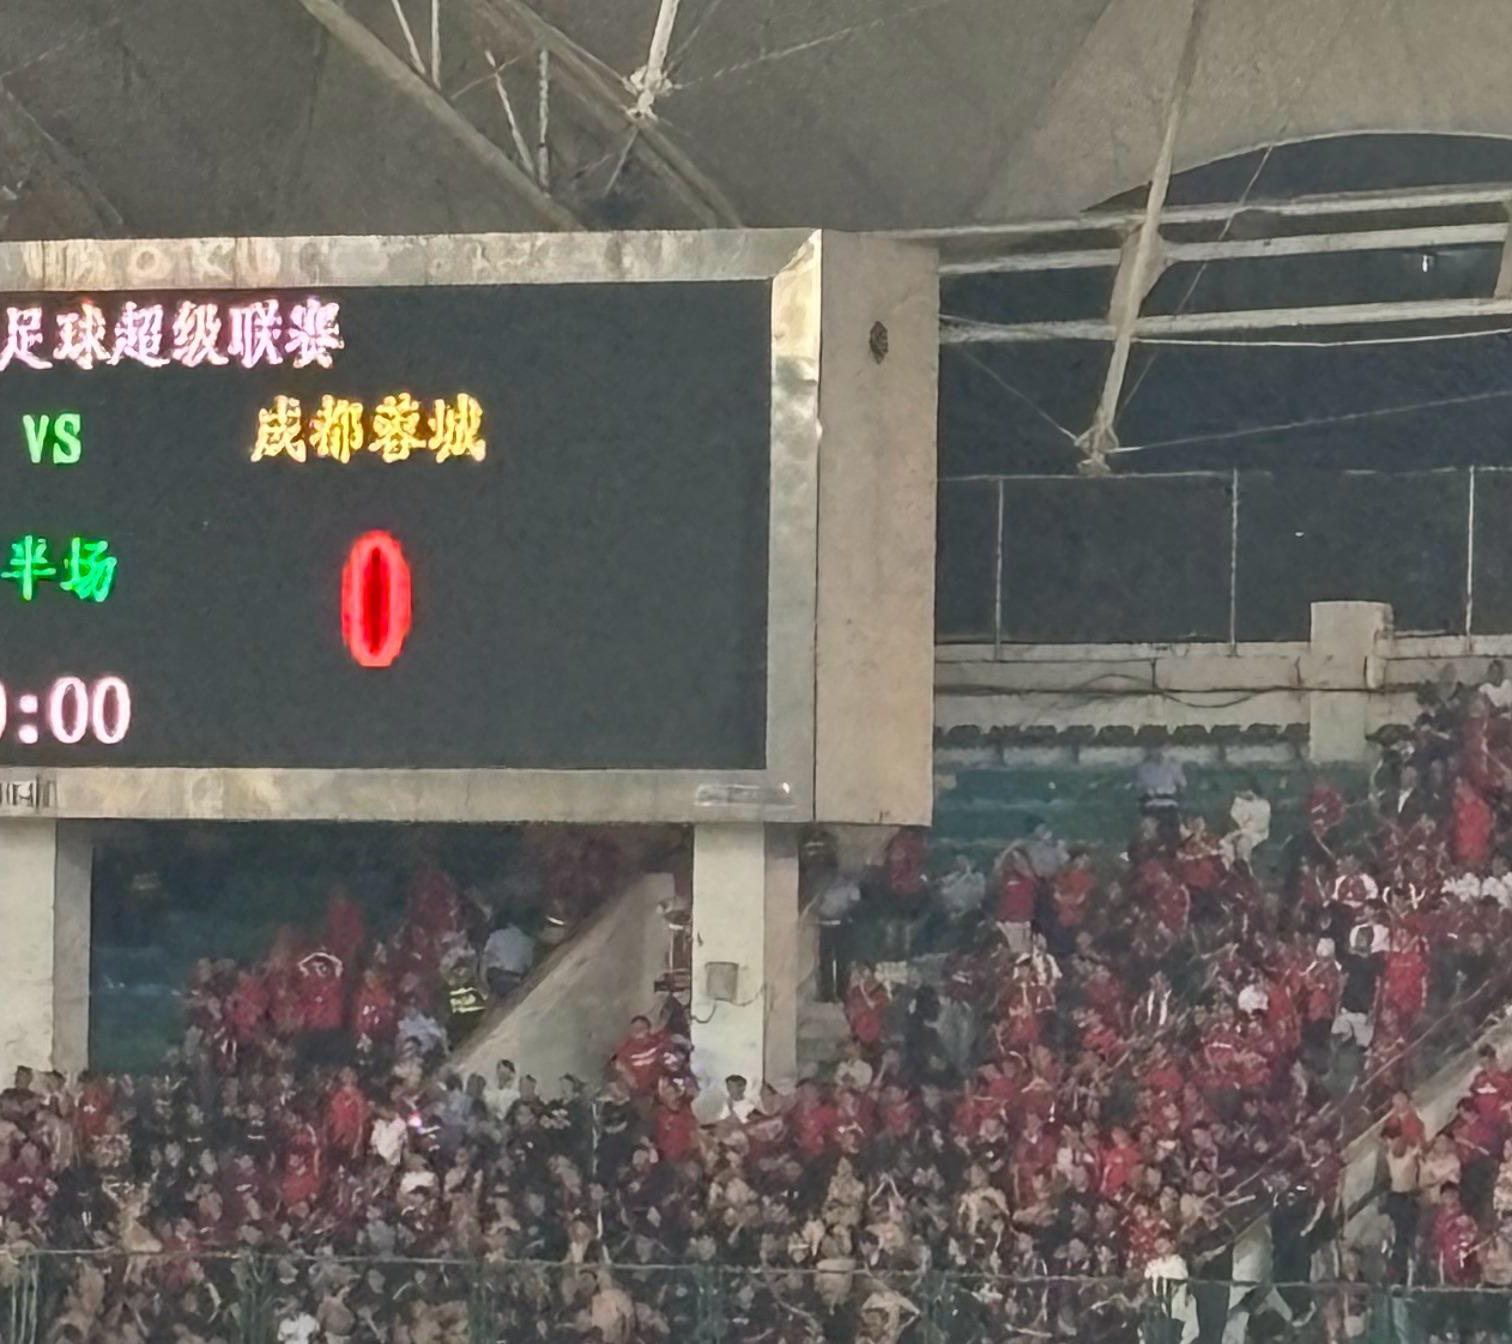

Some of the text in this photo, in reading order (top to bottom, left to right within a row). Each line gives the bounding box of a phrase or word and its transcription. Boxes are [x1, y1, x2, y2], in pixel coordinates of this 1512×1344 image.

[22, 413, 82, 464] VS
[251, 393, 486, 463] 成都蓉城
[341, 530, 413, 668] 0
